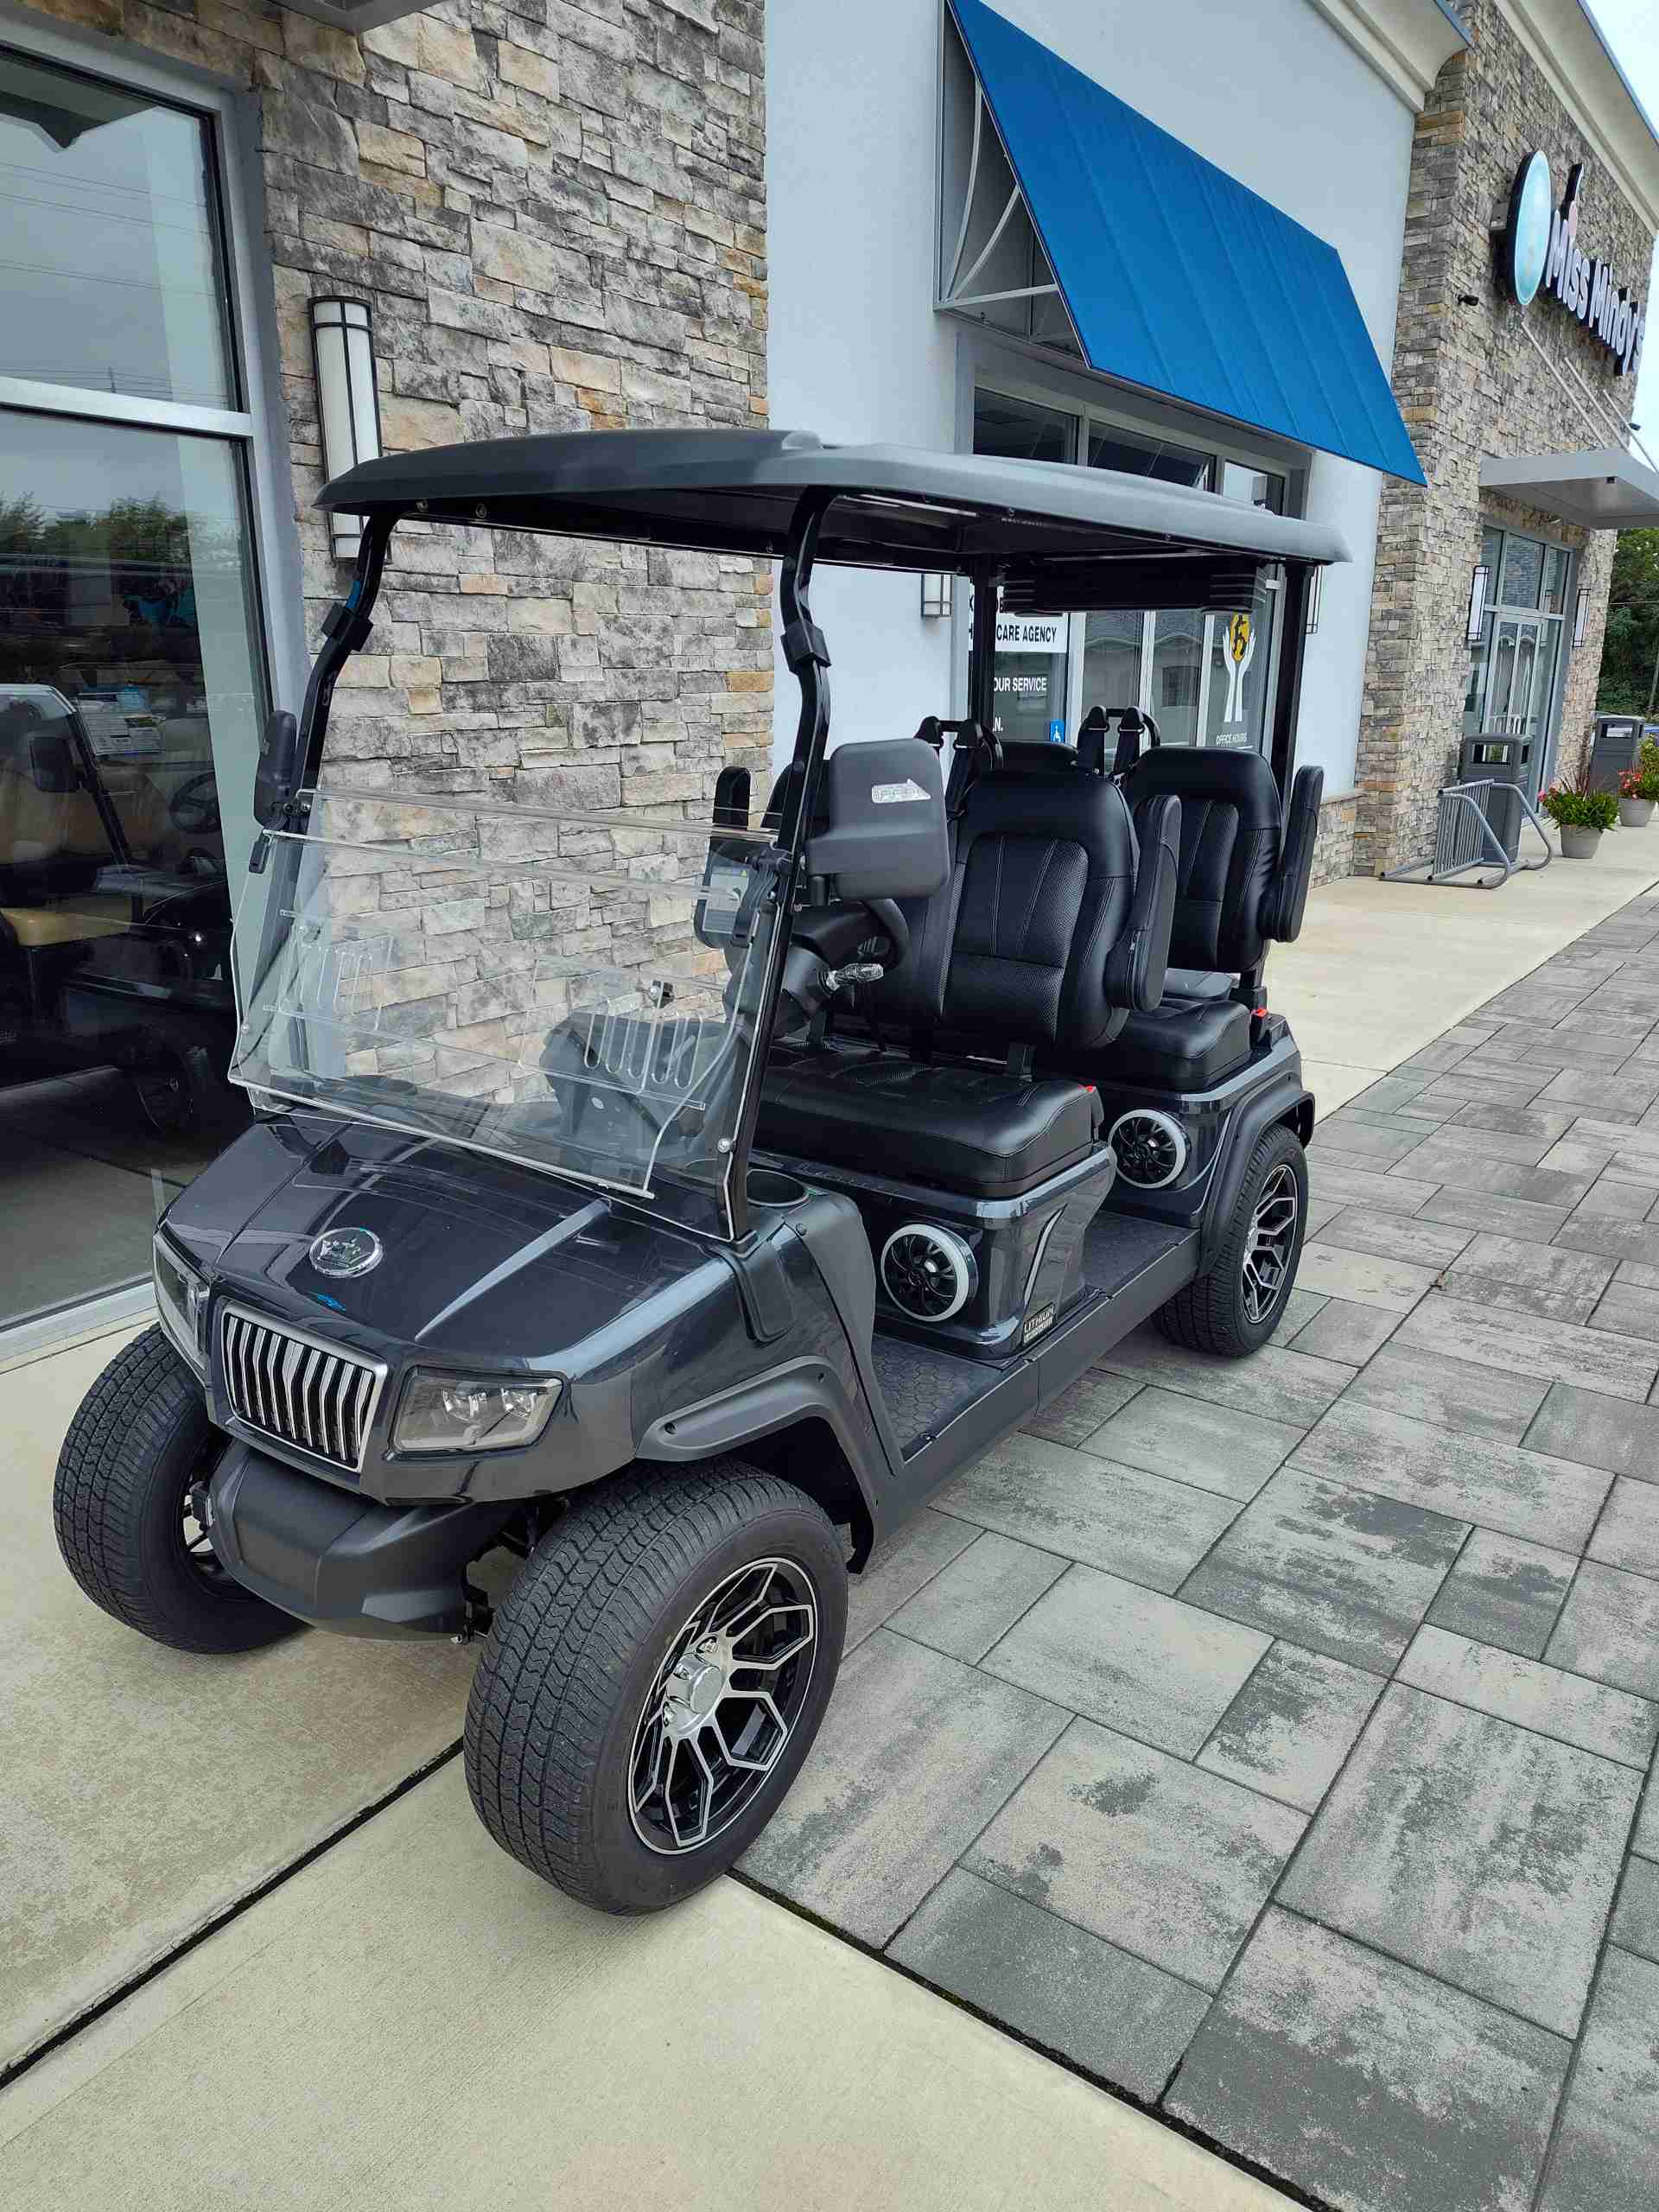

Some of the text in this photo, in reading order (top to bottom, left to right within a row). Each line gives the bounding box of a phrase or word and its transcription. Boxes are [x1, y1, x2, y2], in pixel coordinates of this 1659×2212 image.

[1546, 202, 1591, 321] Miss
[995, 624, 1020, 642] CARE
[1022, 625, 1058, 644] AGENCY
[1012, 677, 1047, 692] SERVICE
